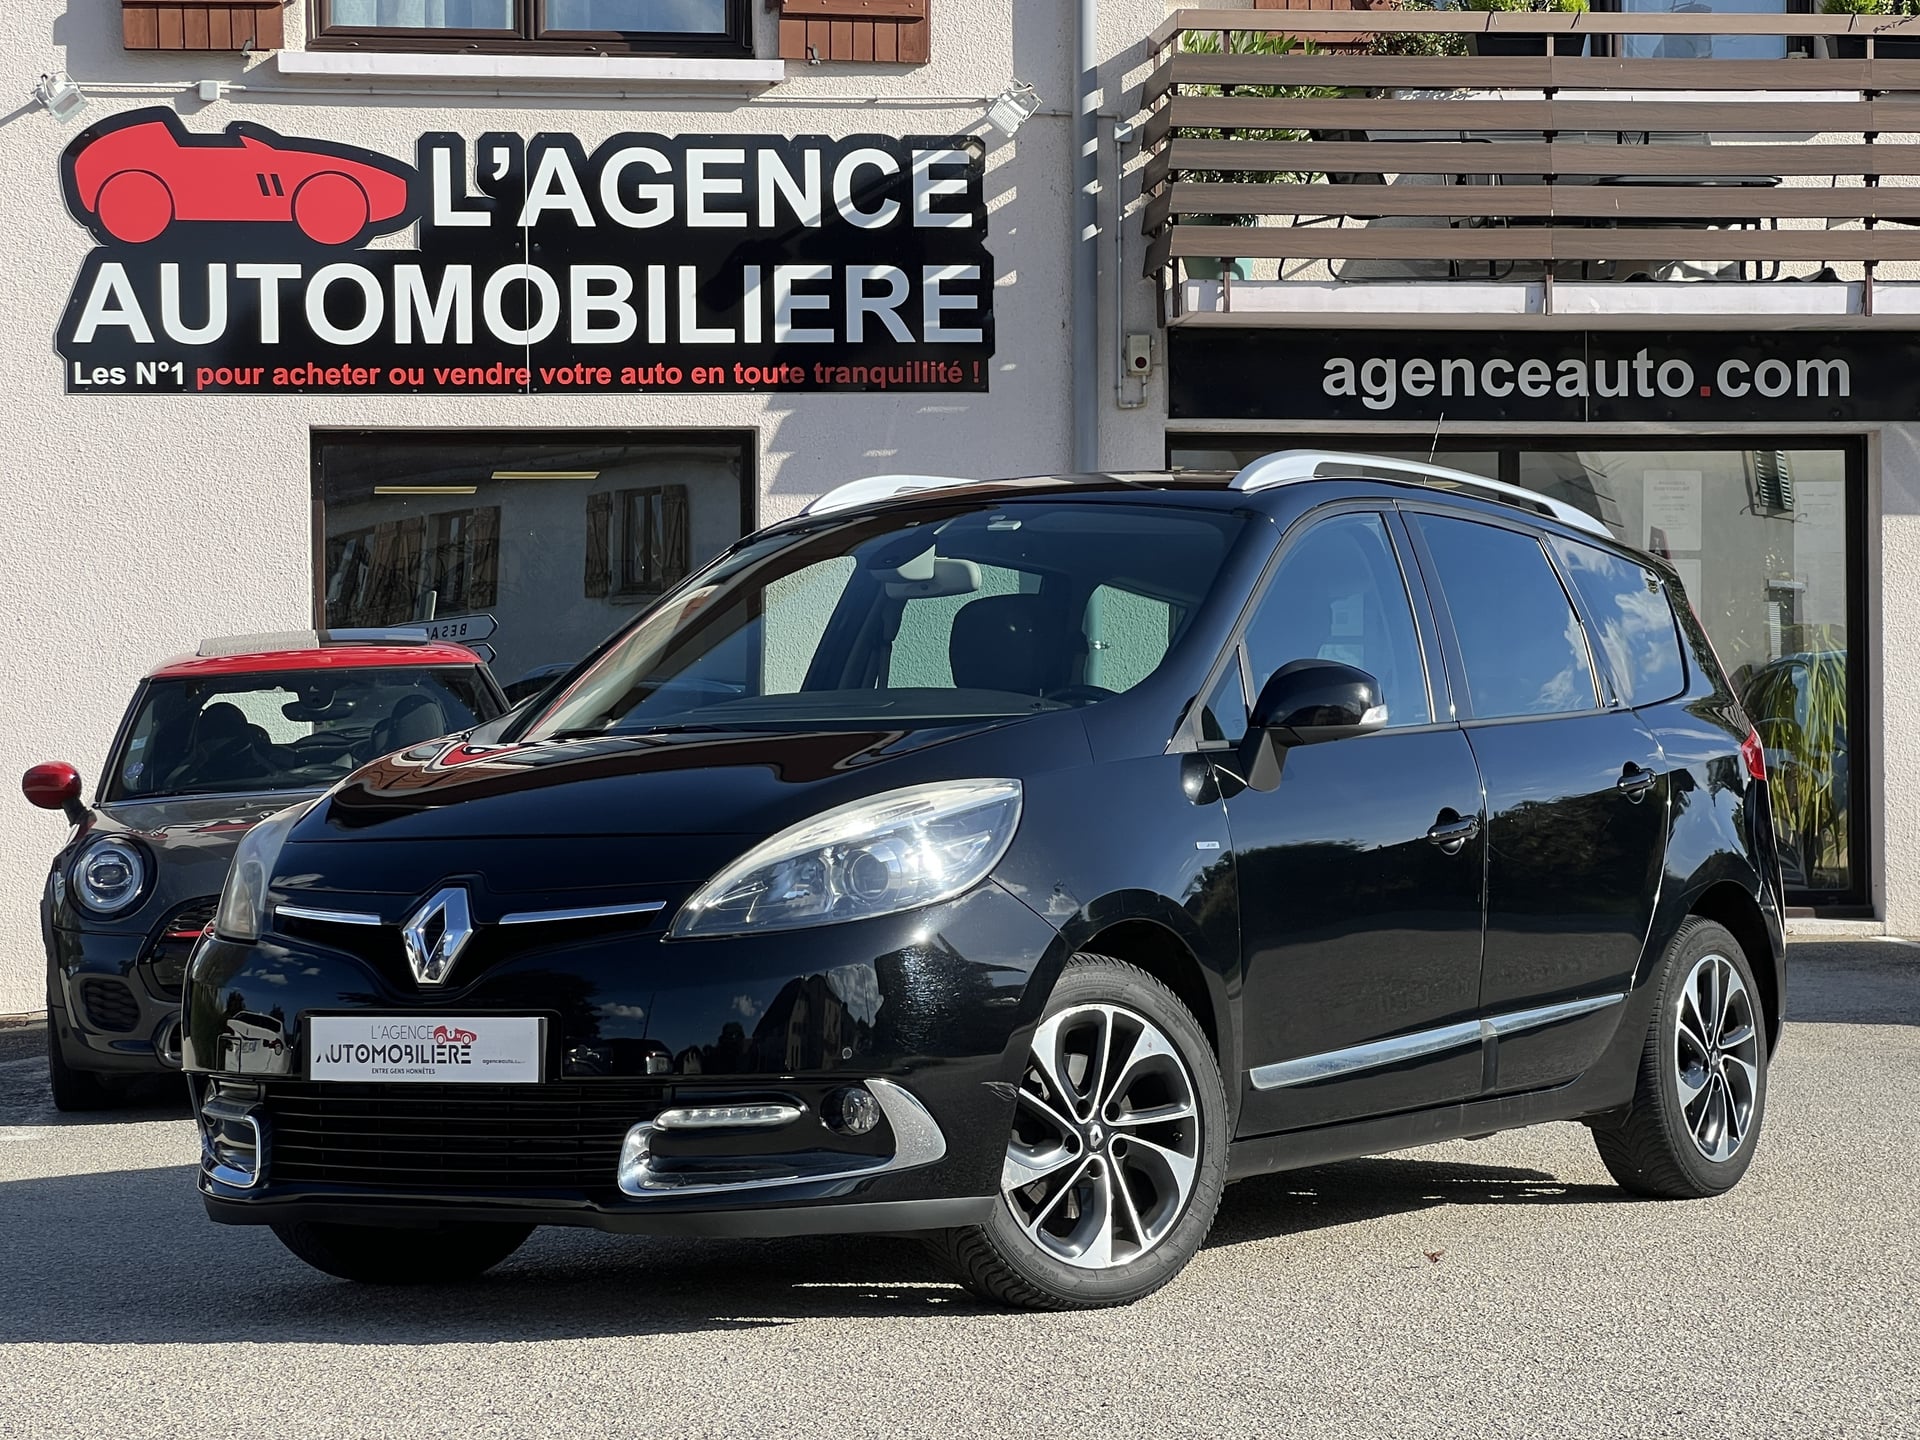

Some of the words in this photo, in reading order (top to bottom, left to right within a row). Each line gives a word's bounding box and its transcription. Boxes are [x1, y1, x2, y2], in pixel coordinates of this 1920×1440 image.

[73, 262, 983, 345] AUTOMOBILIERE
[74, 361, 126, 385] Les
[136, 361, 184, 385] N°1
[197, 367, 264, 390] pour
[272, 362, 380, 385] acheter
[389, 367, 424, 385] ou
[433, 362, 531, 385] vendre
[539, 362, 612, 385] votre
[620, 362, 682, 385] auto
[691, 366, 725, 385] en
[733, 362, 805, 385] toute
[814, 361, 963, 389] tranquillité
[972, 361, 980, 383] !
[1322, 348, 1851, 410] agenceauto.com
[316, 1044, 472, 1064] AUTOMOBILIERE
